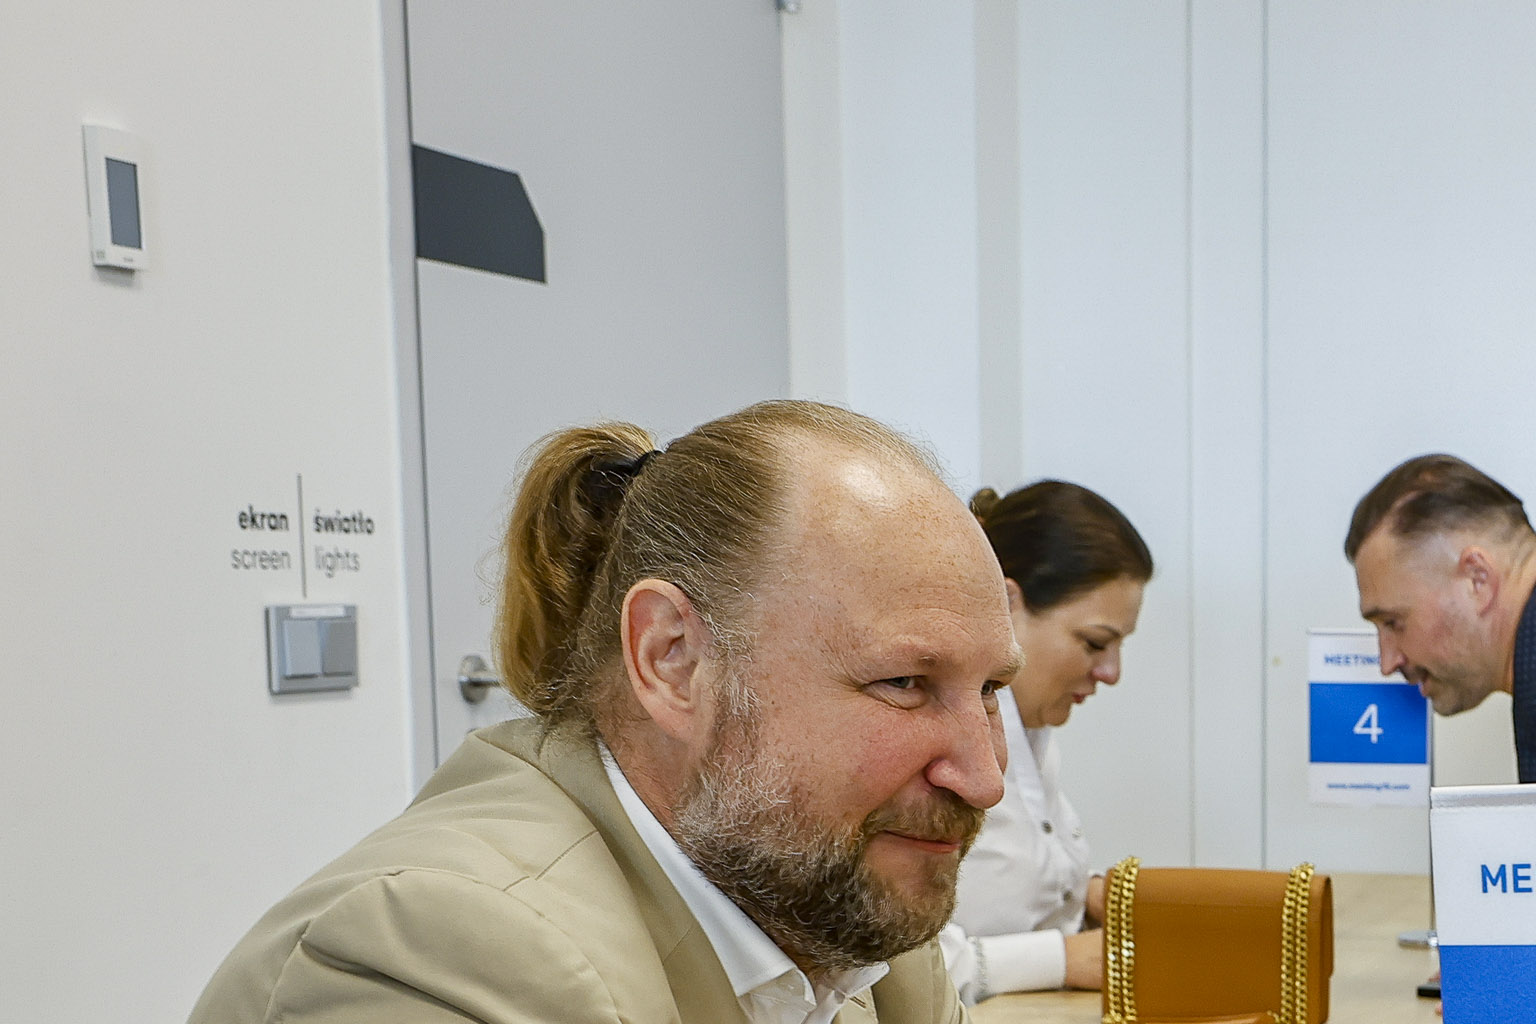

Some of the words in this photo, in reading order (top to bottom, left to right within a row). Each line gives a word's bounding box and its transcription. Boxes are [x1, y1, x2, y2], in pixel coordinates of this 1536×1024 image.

[238, 504, 290, 531] ekran
[231, 549, 291, 570] screen
[314, 545, 361, 578] lights
[1353, 703, 1384, 744] 4
